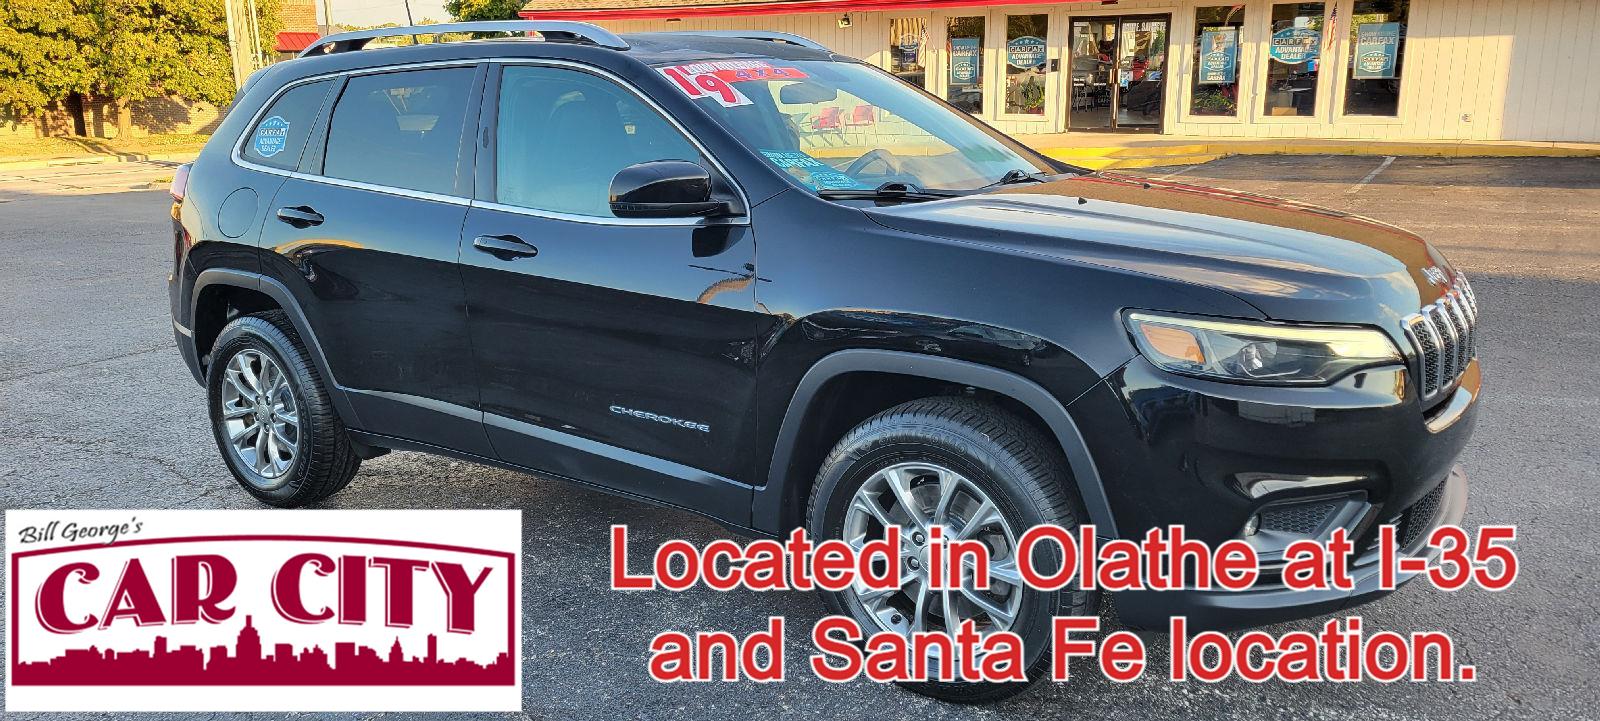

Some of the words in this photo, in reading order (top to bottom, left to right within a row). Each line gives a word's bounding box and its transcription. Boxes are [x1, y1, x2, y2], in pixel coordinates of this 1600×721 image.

[1361, 36, 1396, 45] CARFAX
[1010, 45, 1045, 53] CARFAX
[609, 404, 711, 433] CHEROKEE
